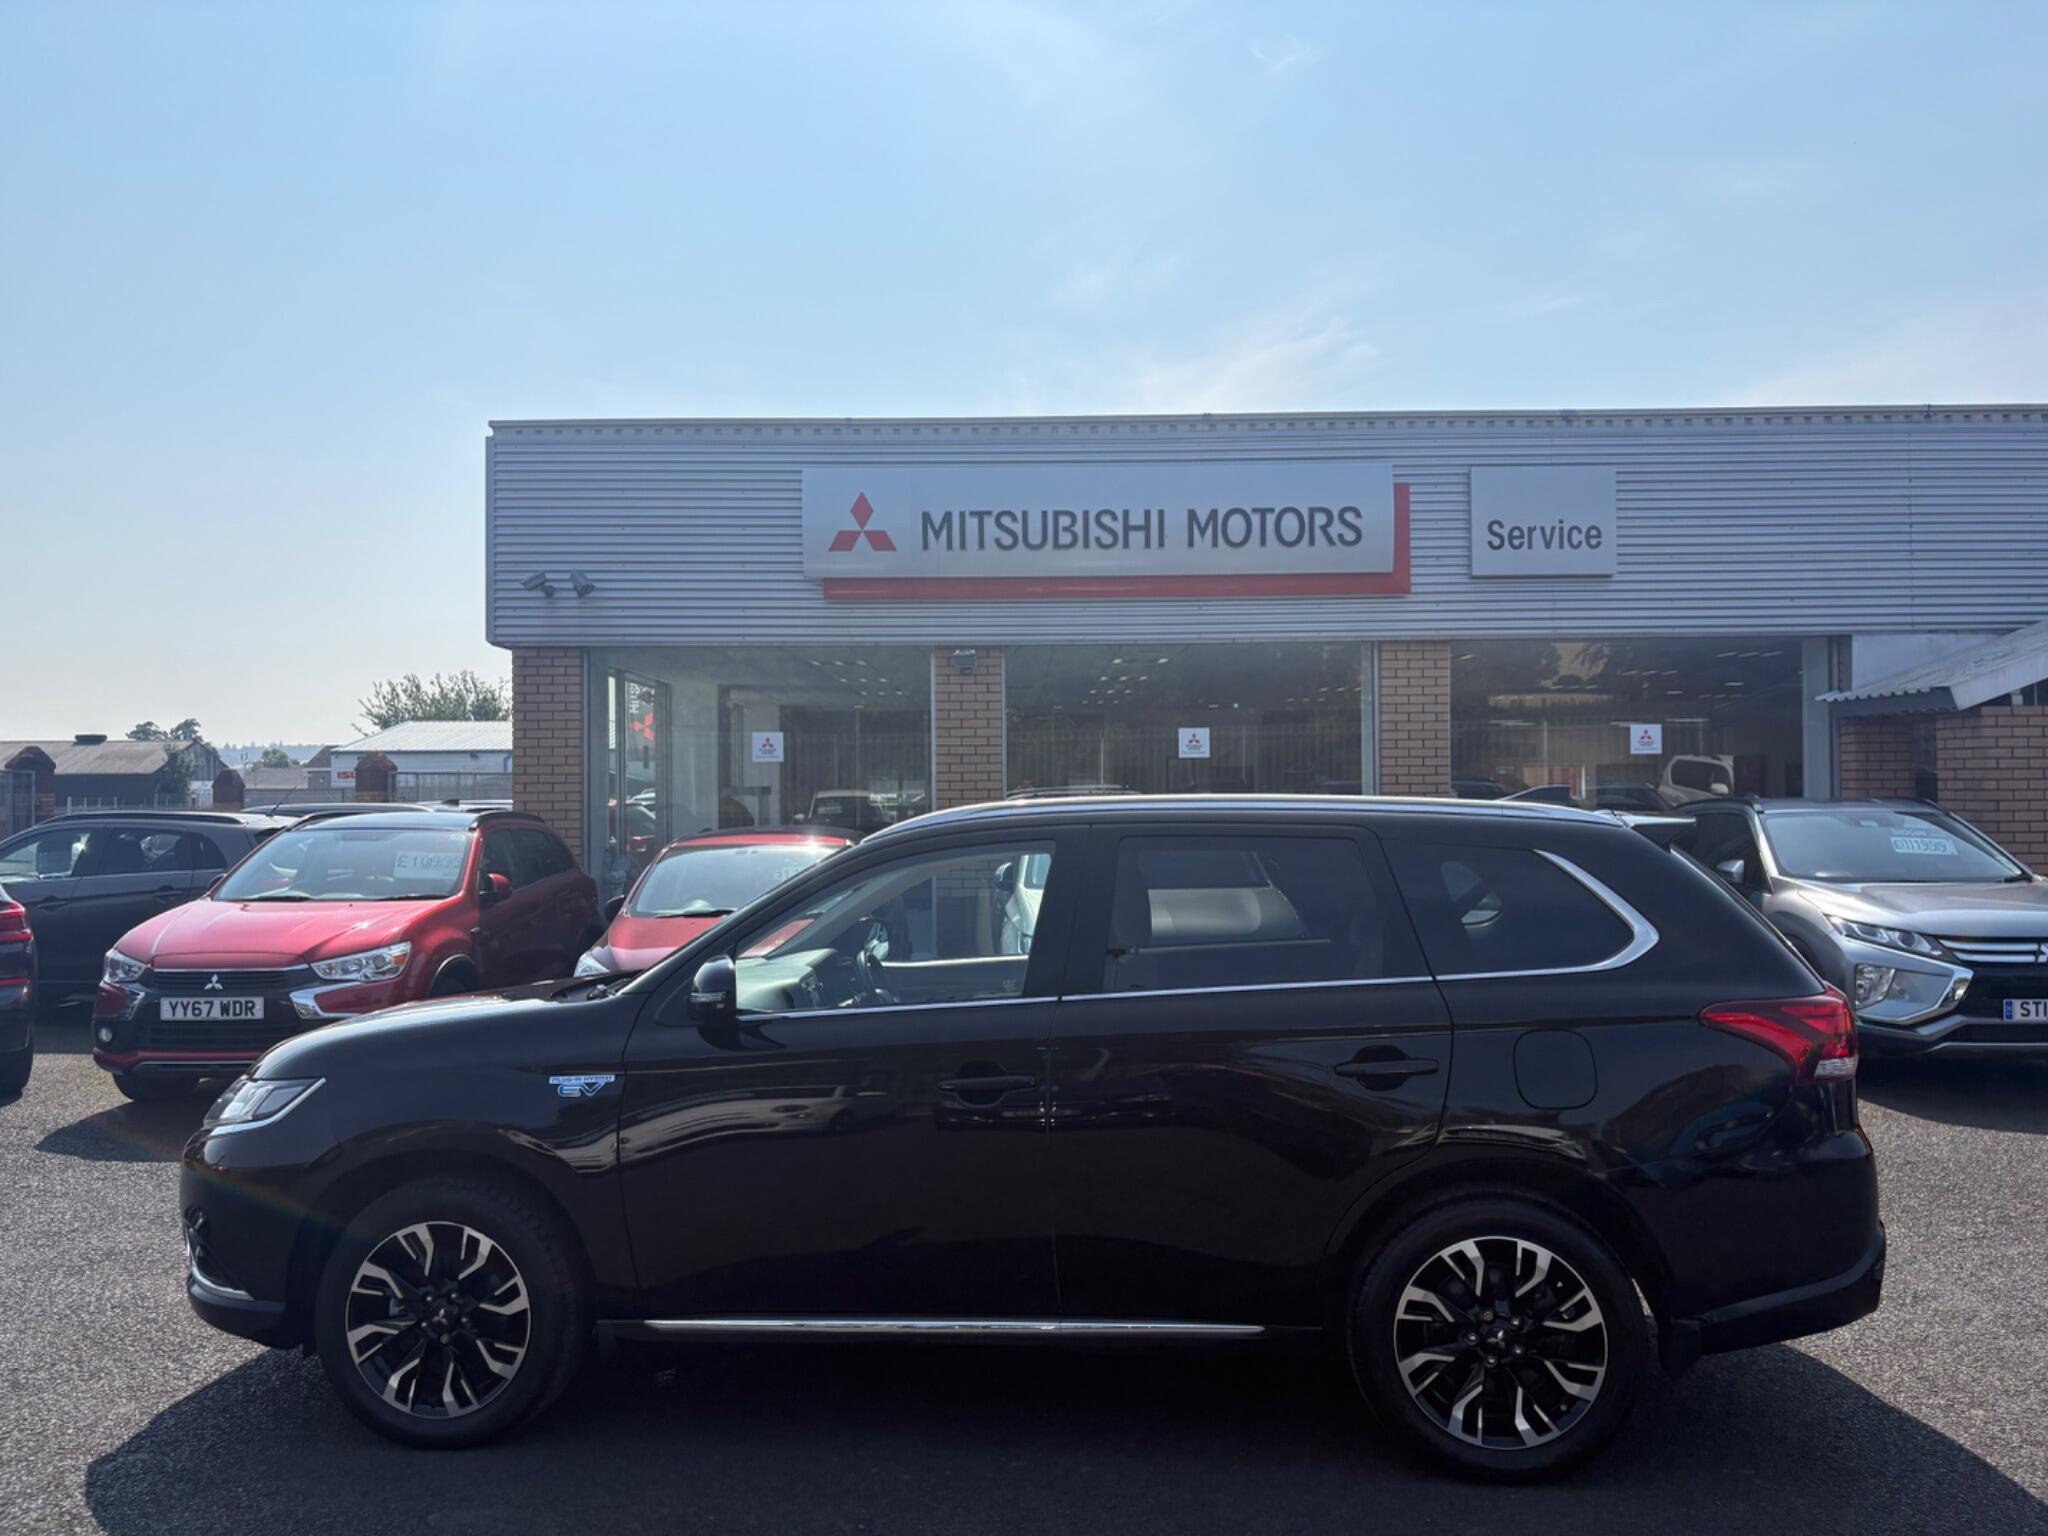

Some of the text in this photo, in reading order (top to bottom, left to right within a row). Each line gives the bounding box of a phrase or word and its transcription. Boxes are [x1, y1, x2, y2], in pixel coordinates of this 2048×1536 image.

[922, 506, 1362, 551] MITSUBISHI MOTORS
[1487, 519, 1602, 550] Service
[169, 1000, 256, 1018] YY67 WDR
